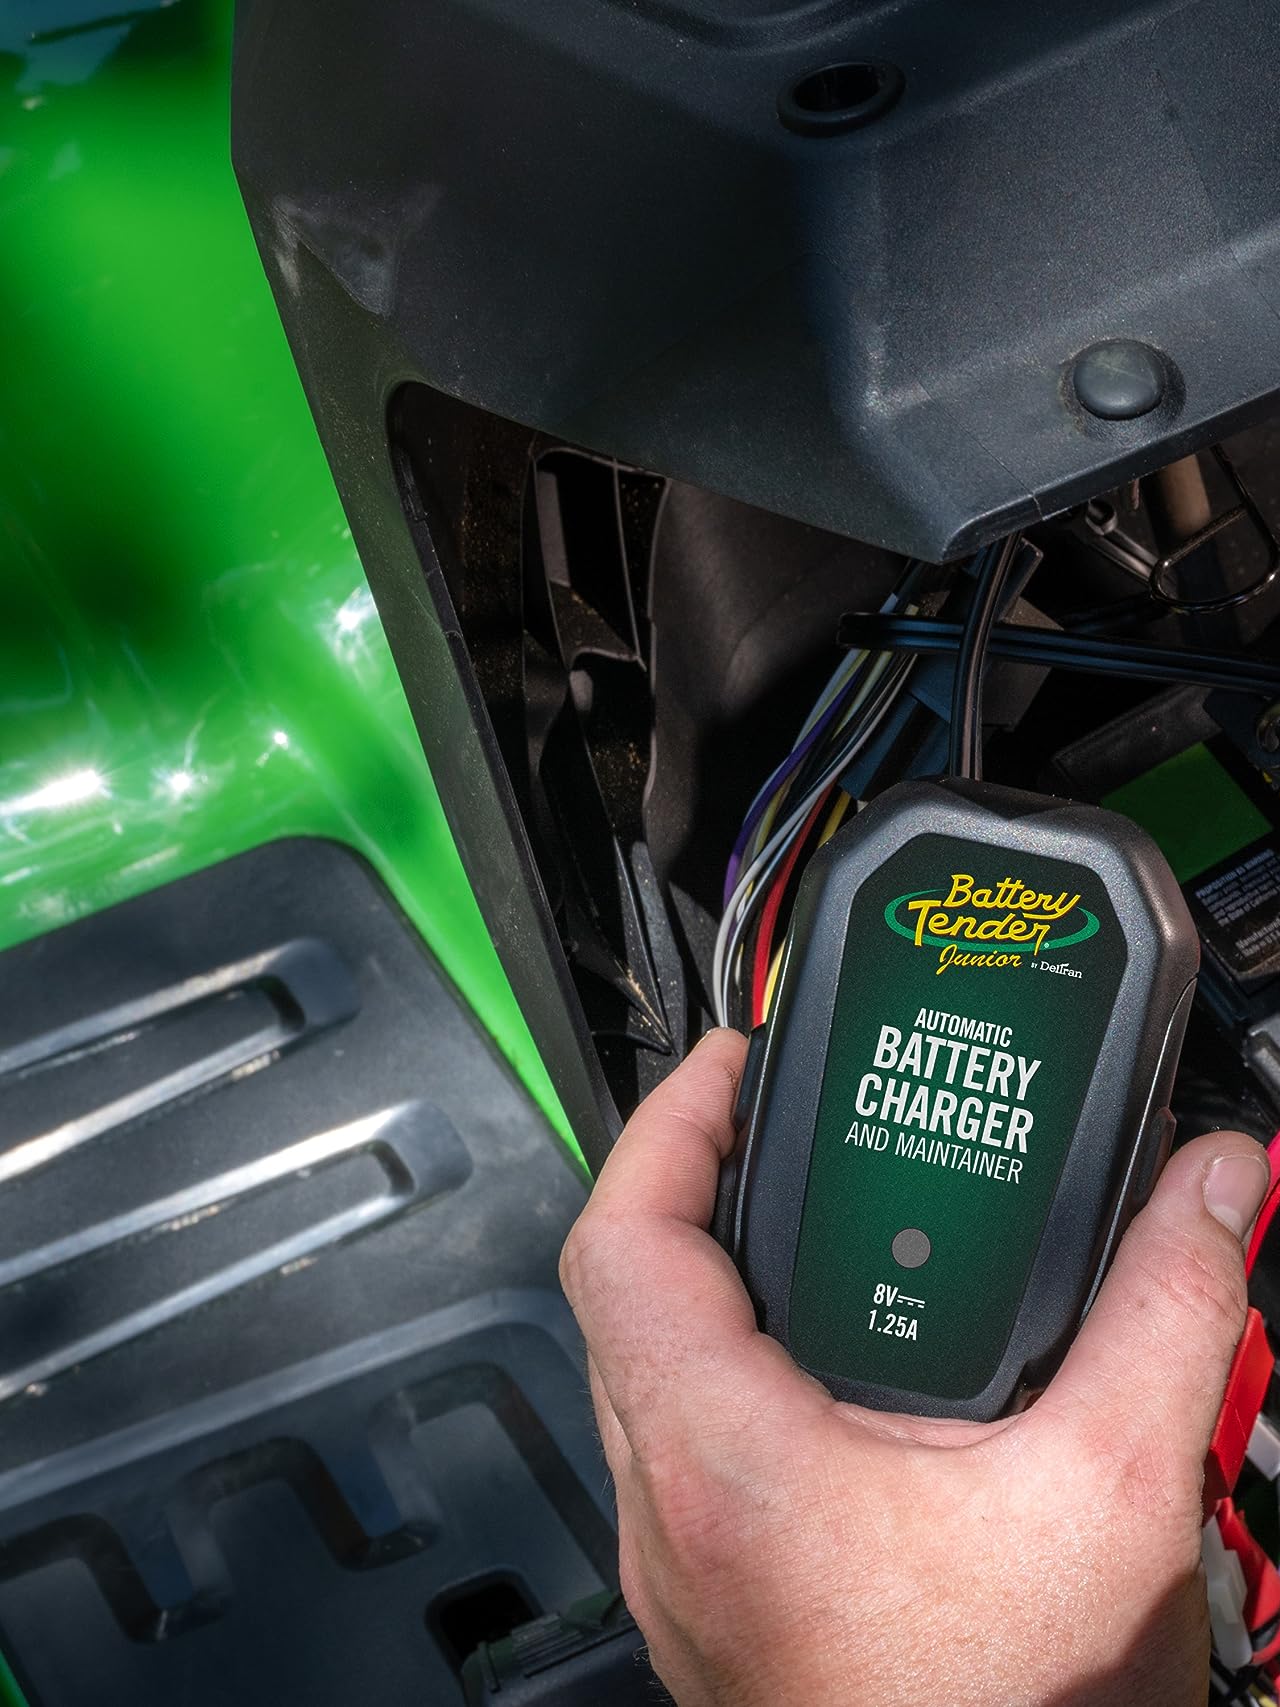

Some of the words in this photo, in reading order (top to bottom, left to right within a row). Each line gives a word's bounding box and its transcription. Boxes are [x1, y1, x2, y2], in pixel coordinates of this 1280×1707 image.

[942, 873, 1081, 920] Battery
[908, 899, 1050, 957] Tender
[936, 943, 1022, 975] Junior
[914, 1007, 1013, 1048] AUTOMATIC
[873, 1024, 1042, 1101] BATTERY
[855, 1073, 1034, 1153] CHARGER
[844, 1121, 889, 1152] AND
[895, 1132, 1024, 1184] MAINTAINER
[873, 1283, 899, 1307] 8V
[868, 1309, 918, 1341] 1.25A
